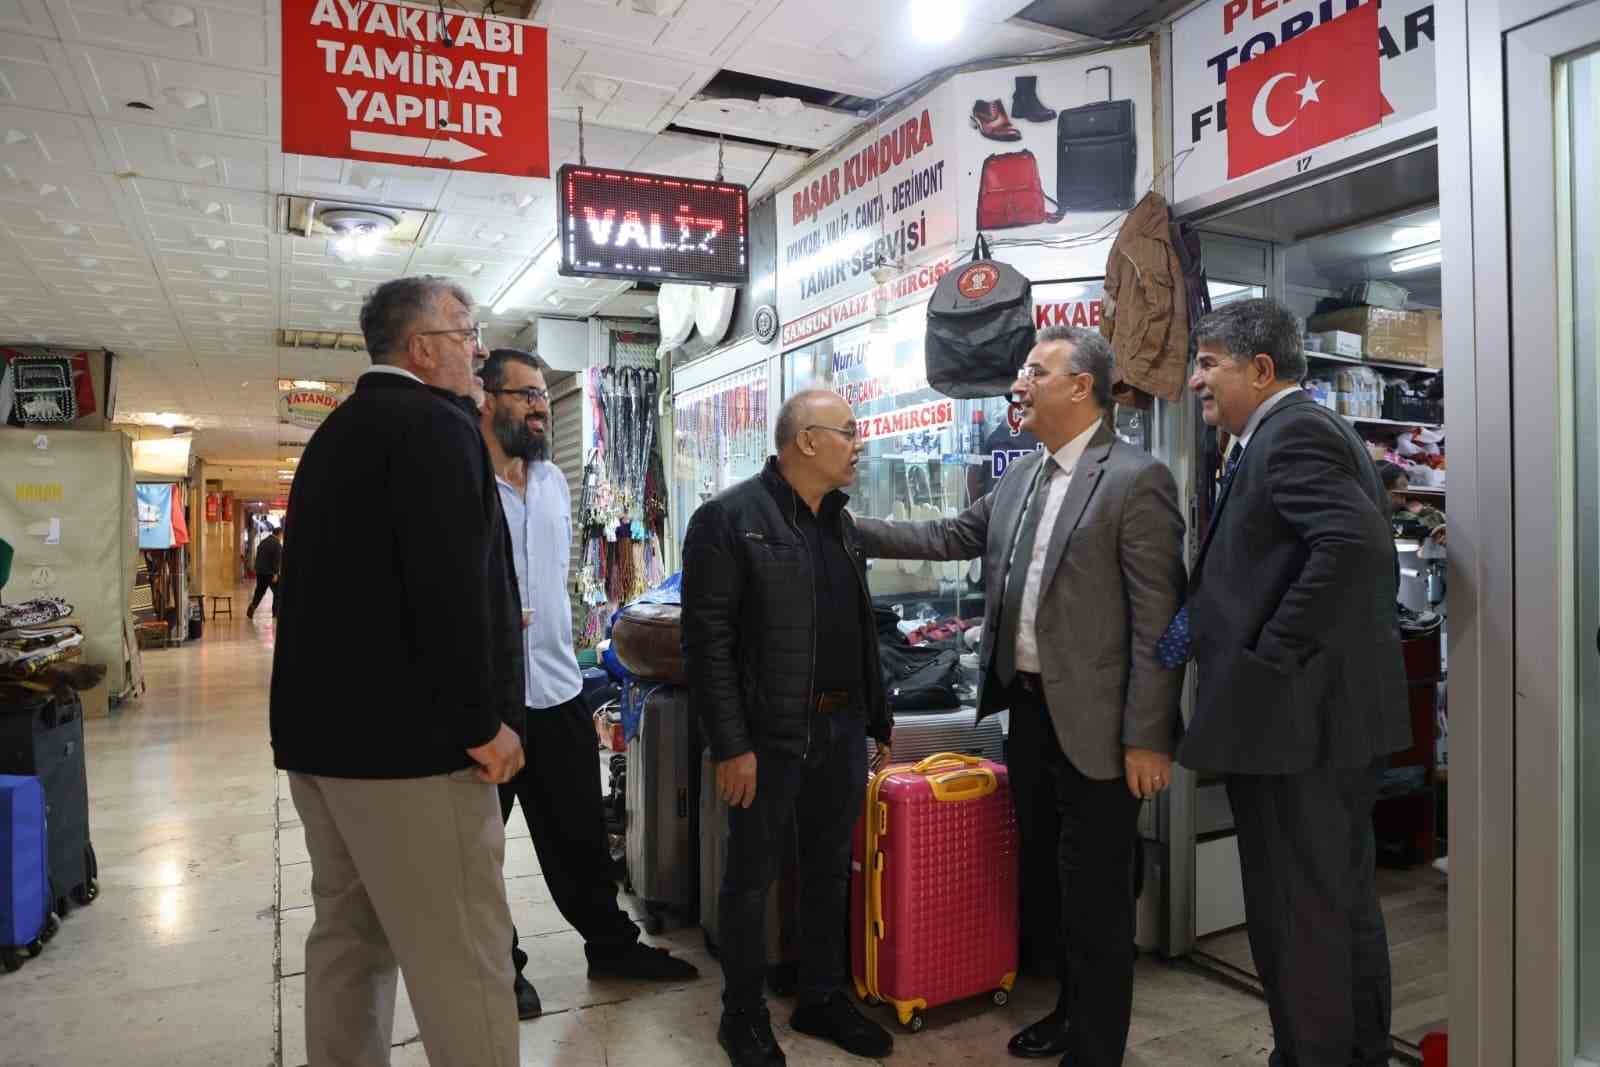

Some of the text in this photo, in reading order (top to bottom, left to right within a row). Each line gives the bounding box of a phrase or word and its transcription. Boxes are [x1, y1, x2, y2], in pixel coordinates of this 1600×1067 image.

[311, 0, 524, 55] AYAKKABI
[316, 39, 518, 97] TAMİRATI
[335, 86, 503, 137] YAPILIR
[792, 108, 934, 226] BAŞAR KUNDURA
[891, 159, 945, 215] DERİMONT
[1296, 155, 1313, 172] 17
[851, 209, 926, 276] SERVİSİ
